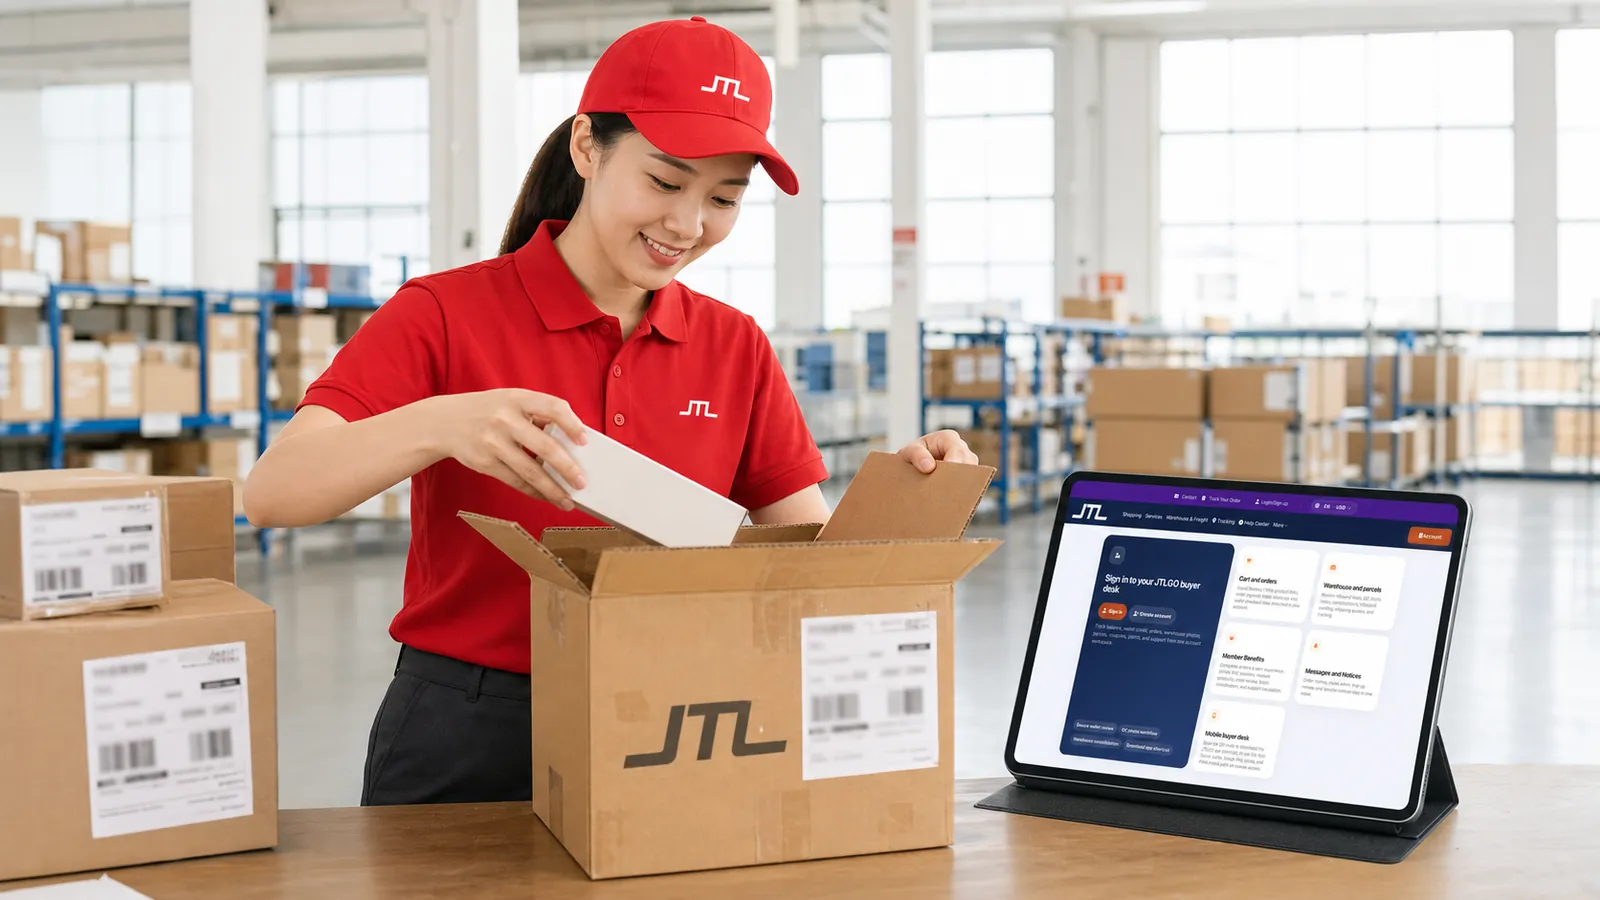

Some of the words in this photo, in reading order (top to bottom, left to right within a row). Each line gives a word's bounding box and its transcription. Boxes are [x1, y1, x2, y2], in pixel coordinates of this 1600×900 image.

[1105, 574, 1120, 584] Sign
[1121, 575, 1128, 583] in
[1129, 576, 1137, 584] to
[1137, 578, 1154, 586] your
[1154, 578, 1179, 588] JTLGO
[1180, 581, 1201, 591] buyer
[1323, 582, 1352, 590] Warehouse
[1102, 585, 1120, 594] desk
[1305, 668, 1331, 676] Messages
